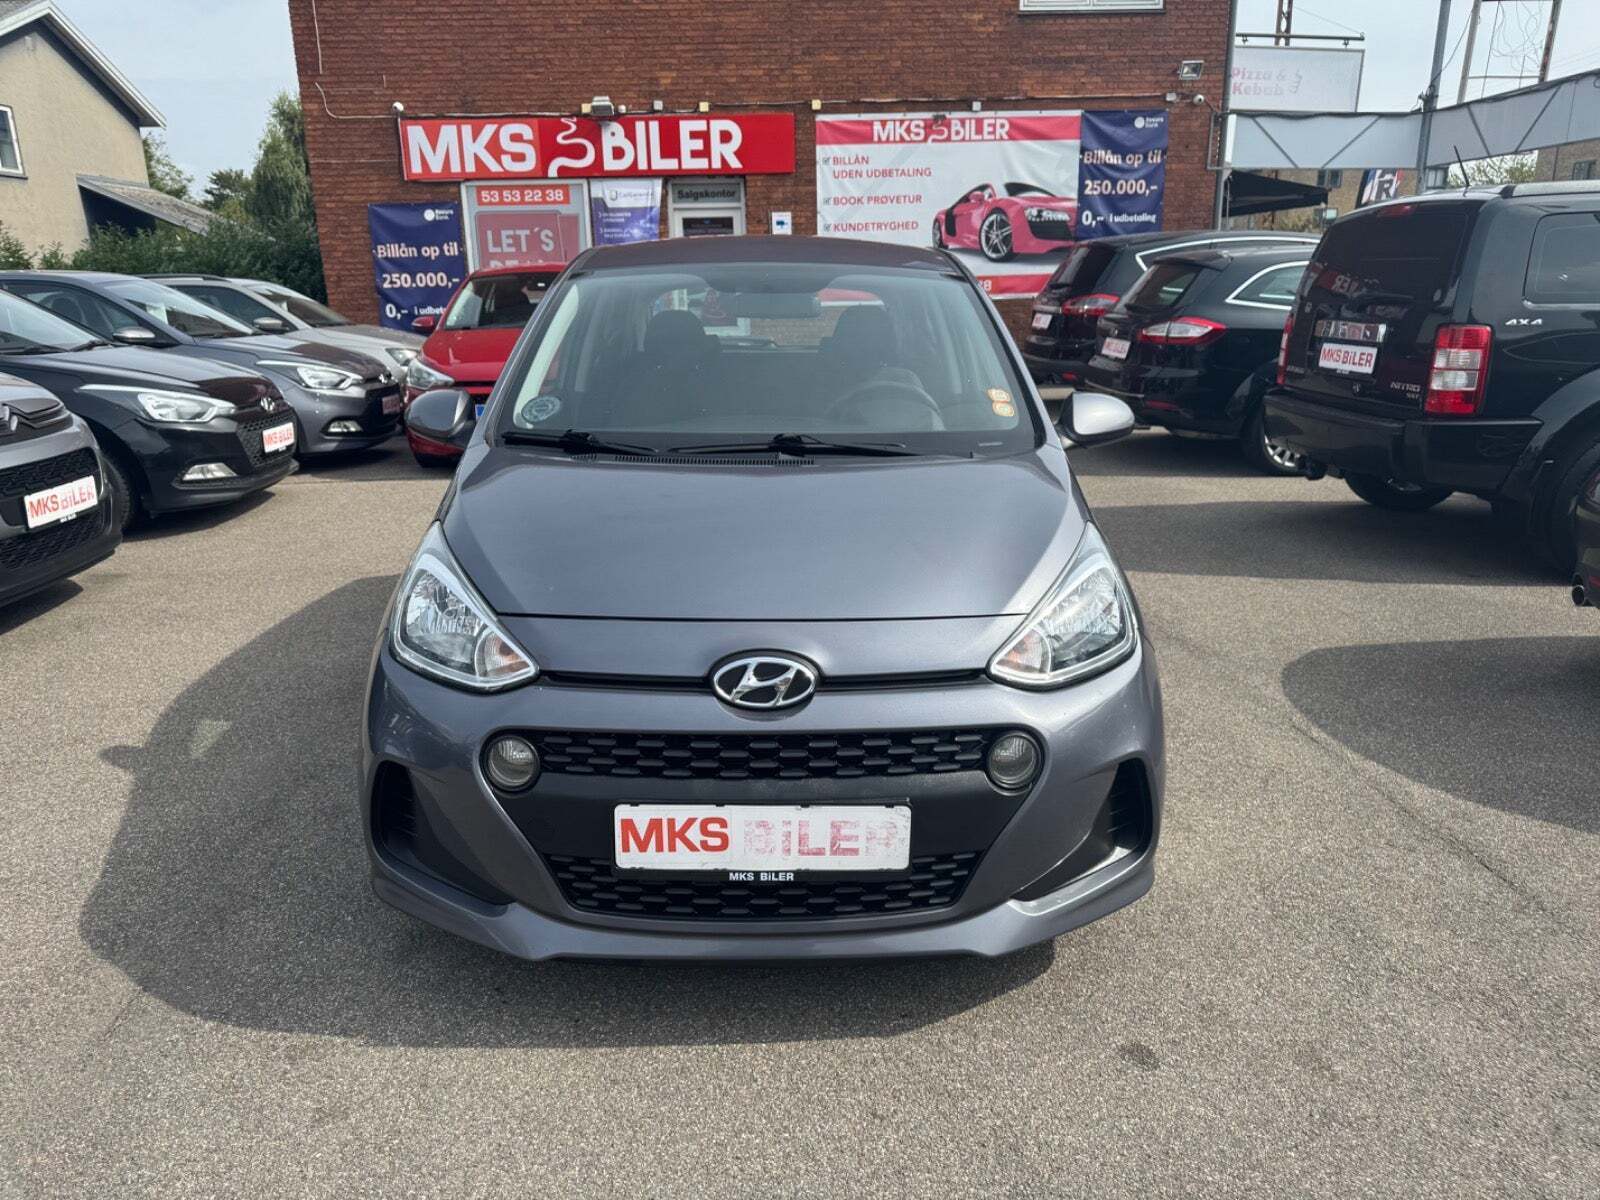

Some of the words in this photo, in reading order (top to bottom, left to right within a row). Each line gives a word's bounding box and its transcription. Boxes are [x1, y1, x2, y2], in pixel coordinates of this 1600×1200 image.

[873, 119, 925, 142] MKS
[951, 118, 1010, 141] BILER
[406, 123, 537, 174] MKS
[601, 119, 743, 171] BILER
[832, 154, 870, 165] BILLÅN
[1083, 150, 1122, 165] Billån
[1125, 153, 1144, 168] op
[1147, 149, 1162, 164] til
[832, 169, 863, 179] UDEN
[866, 167, 932, 178] UDBETALING
[481, 190, 499, 202] 53
[503, 190, 521, 201] 53
[525, 189, 543, 201] 22
[546, 189, 564, 201] 38
[676, 189, 737, 201] Salgskontor
[1083, 179, 1158, 197] 250.000,-
[832, 195, 865, 206] BOOK
[867, 194, 922, 205] PRØVETUR
[833, 220, 919, 233] KUNDETRYGHED
[1114, 212, 1157, 224] udbetaling
[376, 241, 418, 259] Billån
[421, 245, 440, 260] op
[443, 241, 459, 256] til
[382, 271, 460, 289] 250.000,-
[1320, 346, 1341, 363] MKS
[28, 494, 60, 519] MKS
[620, 817, 730, 853] MKS
[729, 871, 755, 882] MKS
